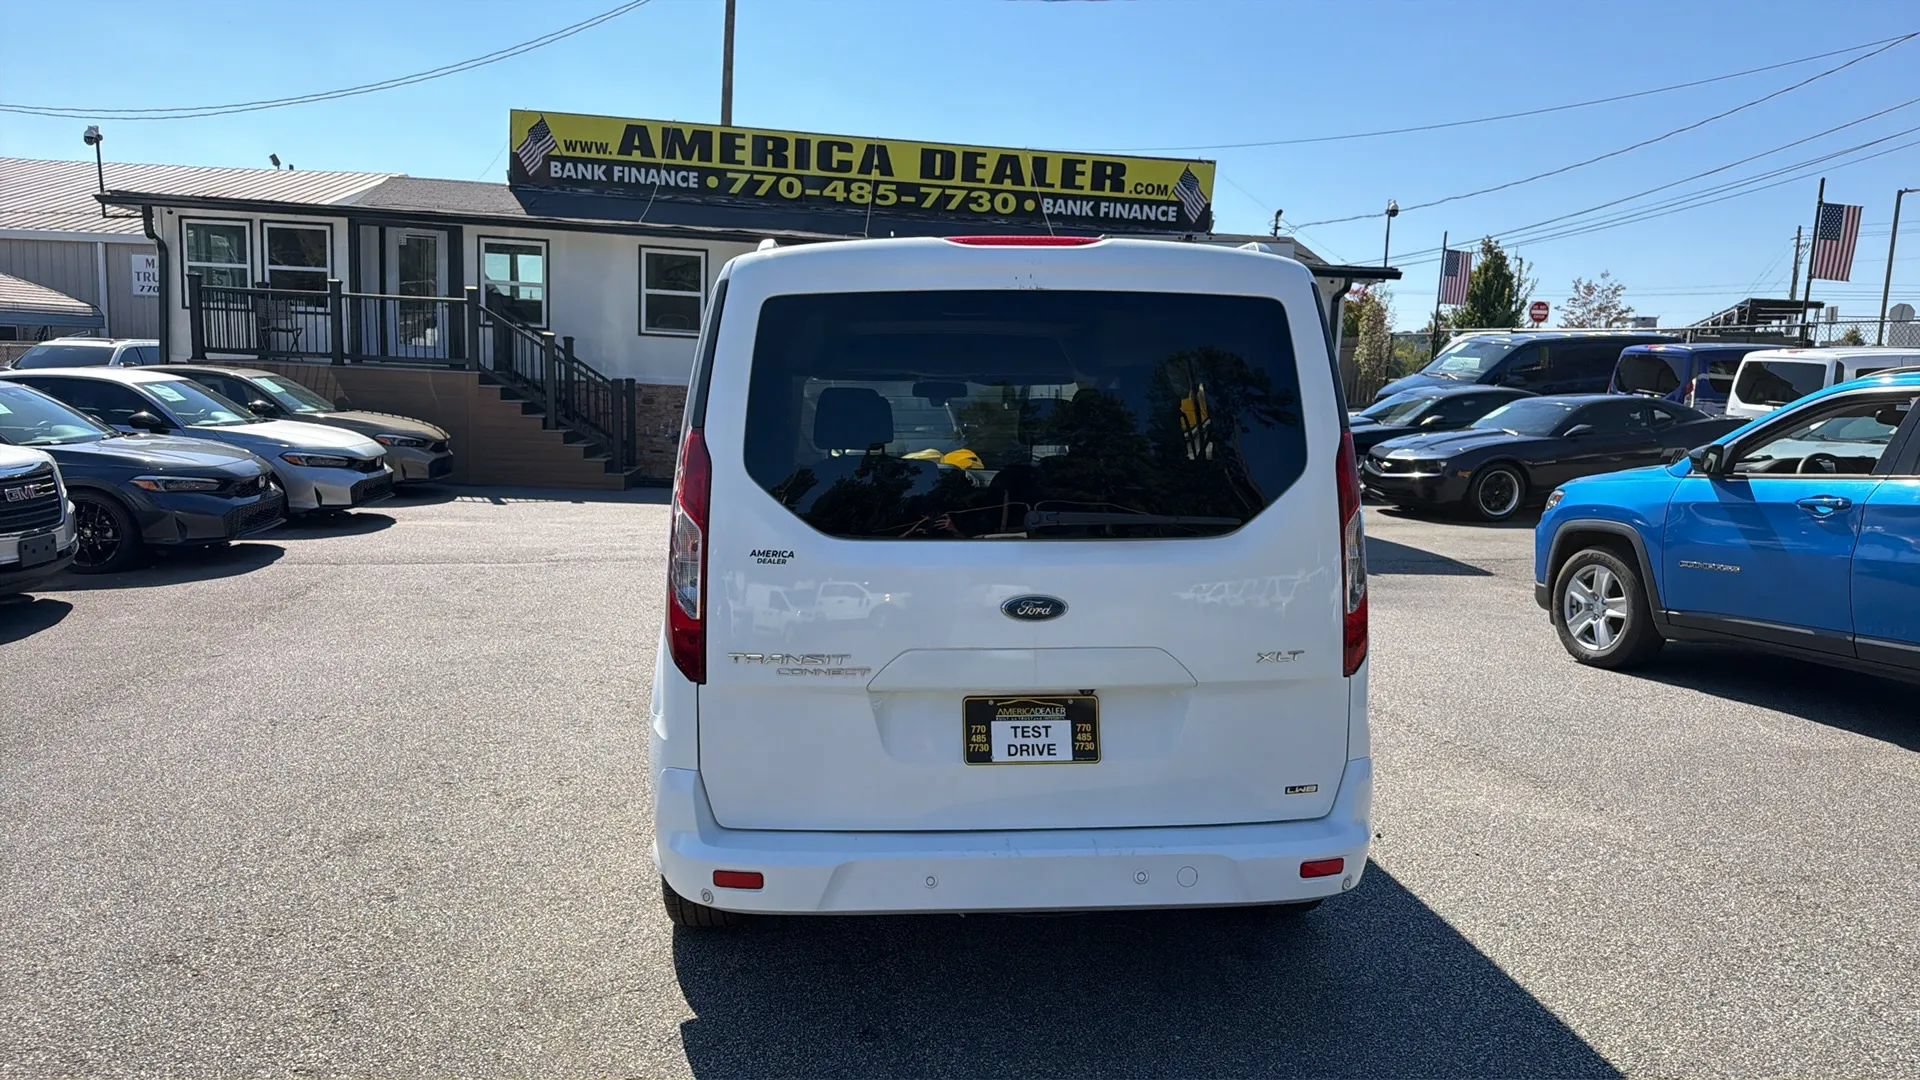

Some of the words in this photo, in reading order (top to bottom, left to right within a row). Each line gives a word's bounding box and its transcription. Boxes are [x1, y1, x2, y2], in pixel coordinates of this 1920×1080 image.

[617, 124, 894, 178] AMERICA
[920, 148, 1126, 193] DEALER
[550, 161, 607, 181] BANK
[613, 165, 699, 188] FINANCE
[726, 172, 1017, 215] 770-485-7730
[1042, 198, 1094, 217] BANK
[1100, 202, 1178, 222] FINANCE
[4, 484, 45, 502] GMC
[750, 549, 795, 559] AMERICA
[1017, 600, 1053, 615] Ford
[728, 652, 851, 665] TRANSIT
[1256, 650, 1305, 663] XLT
[776, 667, 871, 677] CONNECT
[971, 725, 986, 733] 770
[1010, 725, 1052, 738] TEST
[1076, 723, 1091, 732] 770
[971, 734, 986, 743] 485
[1076, 732, 1092, 741] 485
[969, 743, 989, 752] 7730
[1007, 743, 1057, 757] DRIVE
[1075, 742, 1095, 751] 7730
